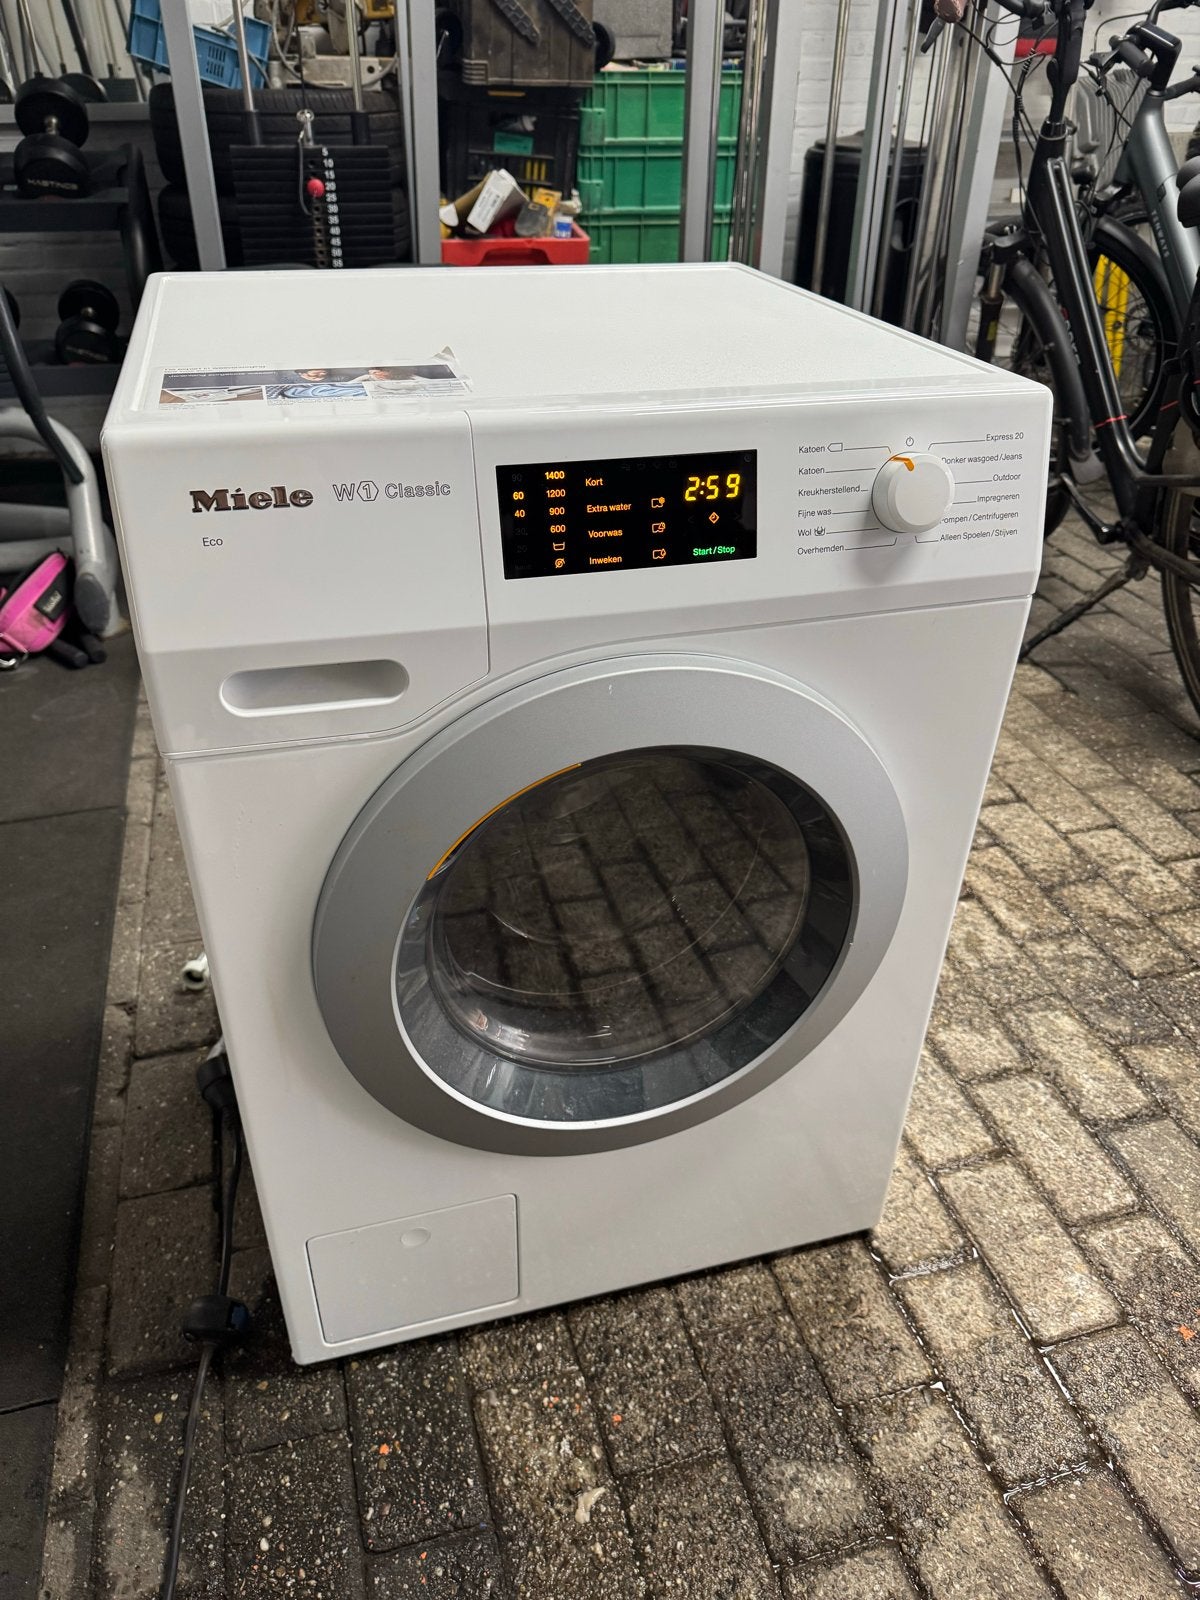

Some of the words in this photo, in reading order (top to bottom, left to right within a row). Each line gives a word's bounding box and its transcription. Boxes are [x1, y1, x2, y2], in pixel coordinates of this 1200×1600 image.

[321, 147, 329, 157] 5
[323, 158, 334, 168] 10
[324, 170, 335, 180] 15
[325, 181, 336, 191] 20
[326, 192, 337, 202] 25
[327, 203, 338, 213] 30
[328, 214, 339, 224] 35
[330, 226, 341, 235] 40
[1151, 209, 1170, 258] TENWAYS
[330, 237, 342, 247] 45
[331, 247, 343, 258] 50
[986, 434, 1012, 442] Express
[1014, 432, 1024, 440] 20
[798, 445, 826, 454] Katoen
[544, 470, 565, 480] 1400
[798, 466, 825, 475] Katoen
[585, 478, 604, 487] Kort
[992, 473, 1021, 482] Outdoor
[684, 473, 741, 502] 2:59
[798, 485, 861, 497] Kreukherstellend
[189, 486, 314, 513] Miele
[384, 480, 451, 499] Classic
[513, 491, 525, 500] 60
[546, 489, 566, 499] 1200
[977, 493, 1020, 503] Impregneren
[549, 507, 565, 516] 900
[586, 504, 608, 513] Extra
[609, 502, 632, 512] water
[798, 507, 815, 518] Fijne
[514, 509, 526, 518] 40
[550, 525, 566, 534] 600
[588, 528, 623, 539] Voorwas
[798, 529, 812, 537] Wol
[940, 531, 962, 542] Alleen
[202, 537, 223, 547] Eco
[693, 545, 736, 556] Start/Stop
[797, 544, 845, 556] Overhemden
[589, 555, 623, 565] Inweken
